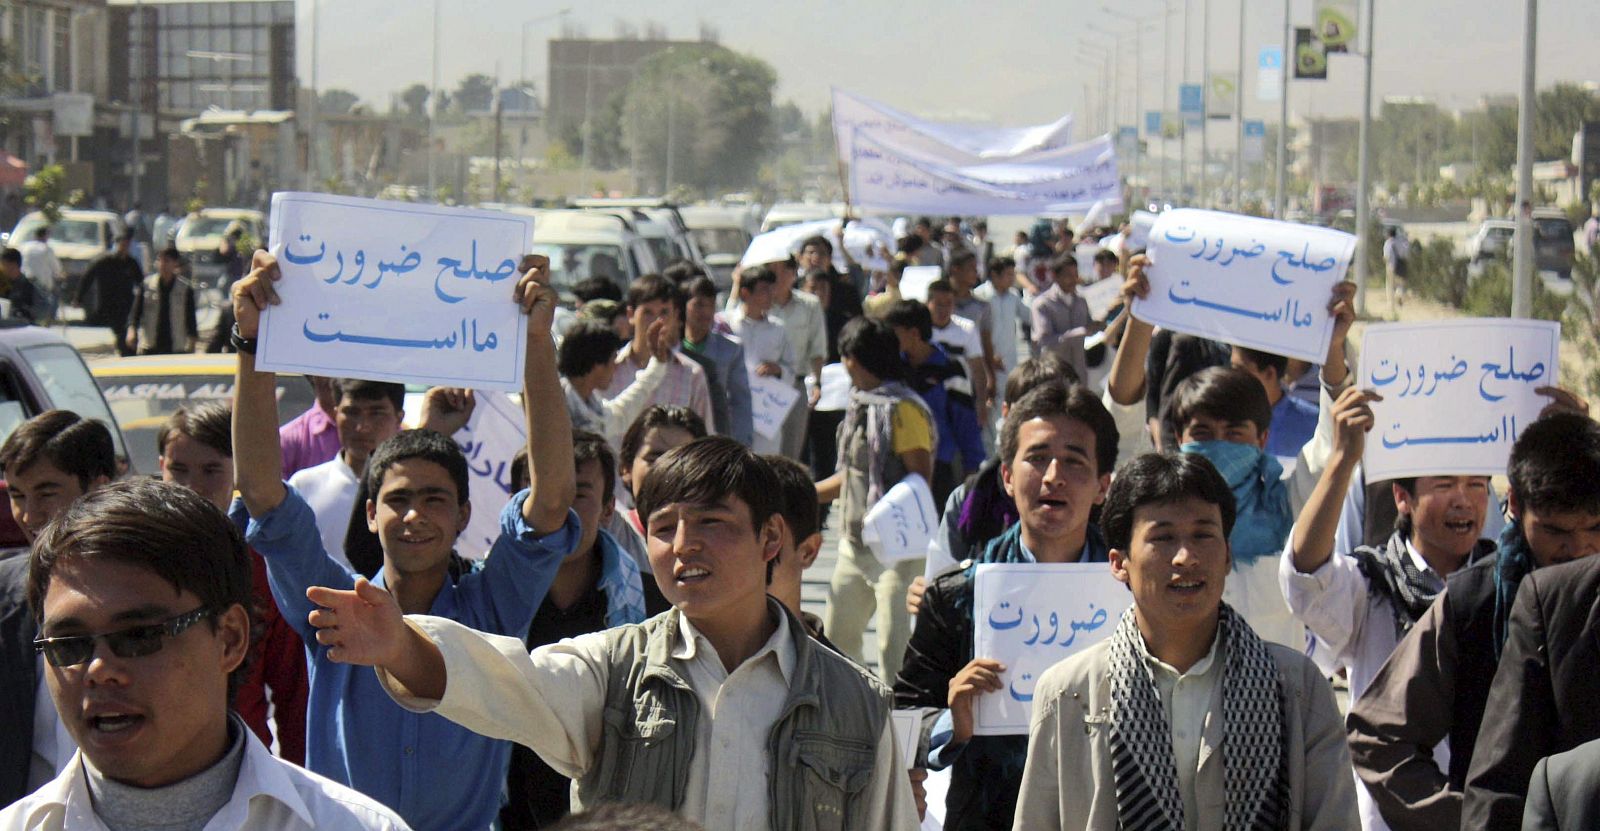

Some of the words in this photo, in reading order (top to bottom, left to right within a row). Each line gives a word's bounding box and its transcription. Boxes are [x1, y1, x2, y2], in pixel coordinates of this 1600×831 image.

[284, 235, 422, 289] ضرورت
[1165, 226, 1266, 266] ضرورت
[1271, 242, 1336, 285] صلح
[434, 239, 516, 304] صلح
[1371, 355, 1468, 397] ضرورت
[1479, 346, 1546, 402] صلح
[988, 602, 1108, 648] ضرورت
